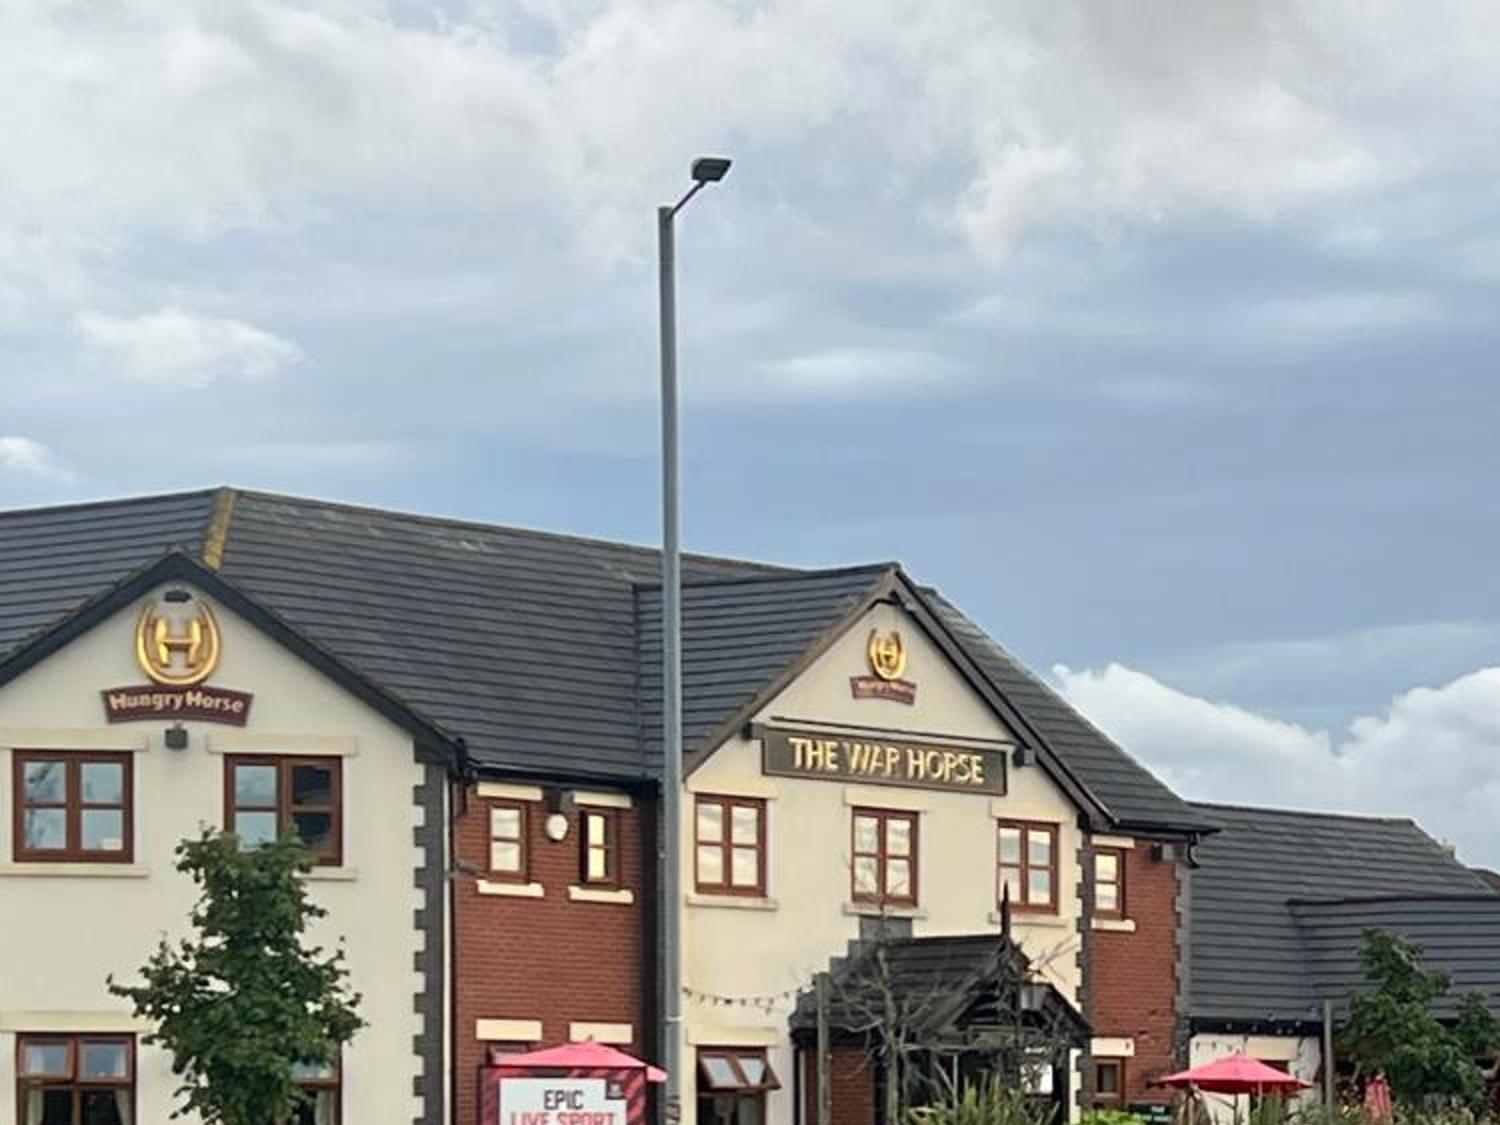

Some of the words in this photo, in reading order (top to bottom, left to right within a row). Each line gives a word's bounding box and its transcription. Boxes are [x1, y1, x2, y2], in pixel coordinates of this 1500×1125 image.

[108, 692, 183, 711] Hungry
[186, 691, 244, 713] Horse
[788, 737, 839, 770] THE
[543, 1089, 584, 1110] EPIC
